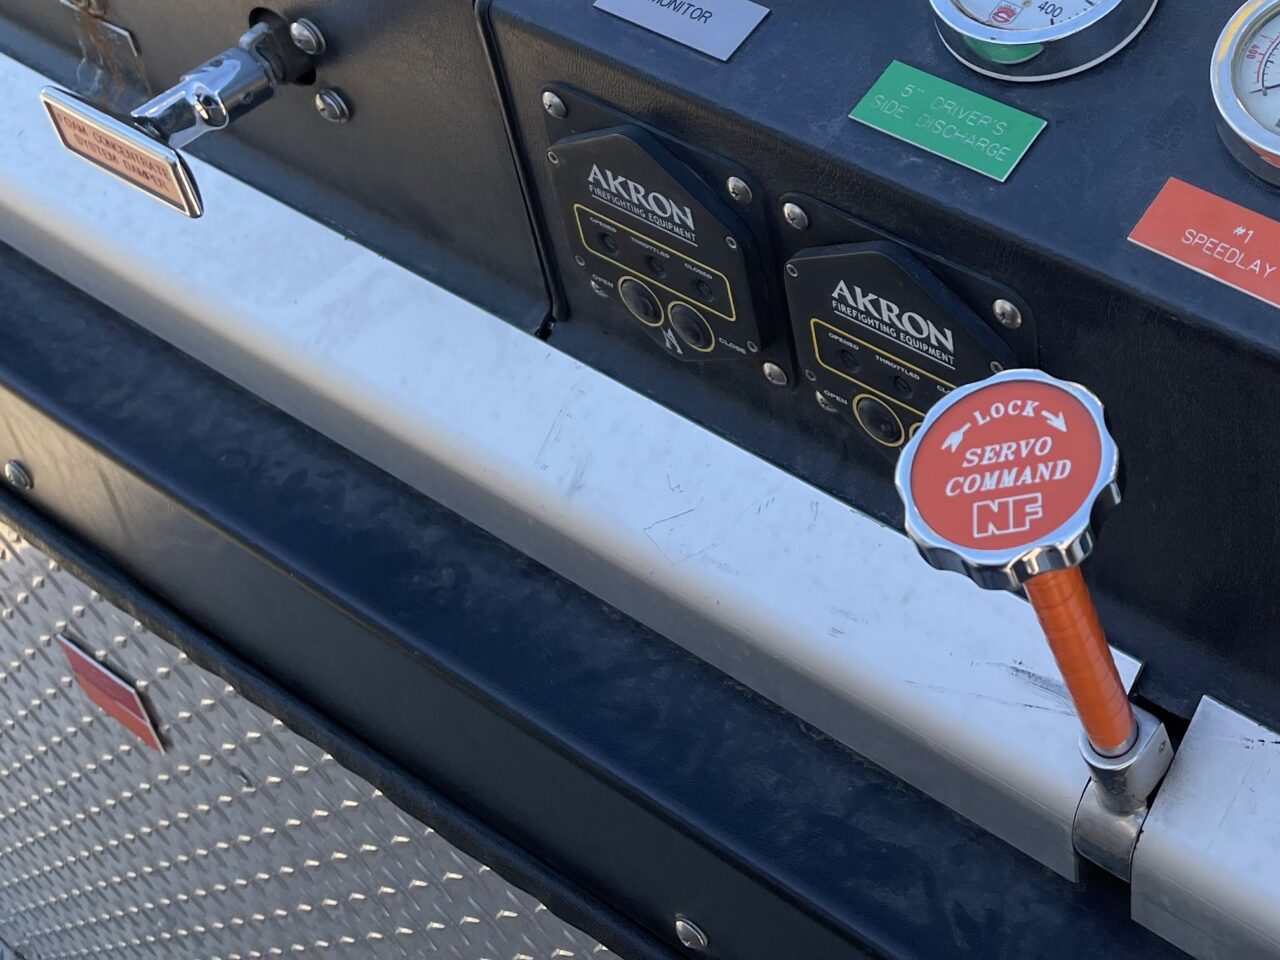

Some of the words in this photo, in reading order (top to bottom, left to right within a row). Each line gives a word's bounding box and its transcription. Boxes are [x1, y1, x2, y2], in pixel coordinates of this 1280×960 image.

[1037, 0, 1064, 18] 400
[870, 94, 910, 120] SIDE
[915, 113, 1012, 162] DISCHARGE
[930, 96, 1007, 136] DRIVER'S
[587, 163, 695, 231] AKRON
[588, 184, 646, 219] FIREFIGHTING
[648, 214, 697, 242] EQUIPMENT
[1232, 225, 1254, 244] #1
[1181, 228, 1277, 278] SPEEDLAY
[591, 273, 614, 289] OPEN
[684, 262, 713, 280] CLOSED
[831, 279, 954, 354] AKRON
[831, 300, 897, 338] FIREFIGHTING
[900, 331, 956, 365] EQUIPMENT
[718, 336, 747, 354] CLOSE
[828, 331, 860, 351] OPENED
[875, 354, 921, 380] THROTTLED
[823, 389, 848, 406] OPEN
[973, 400, 1039, 426] LOCK
[962, 435, 1053, 468] SERVO
[944, 459, 1072, 497] COMMAND
[973, 492, 1043, 538] NF
